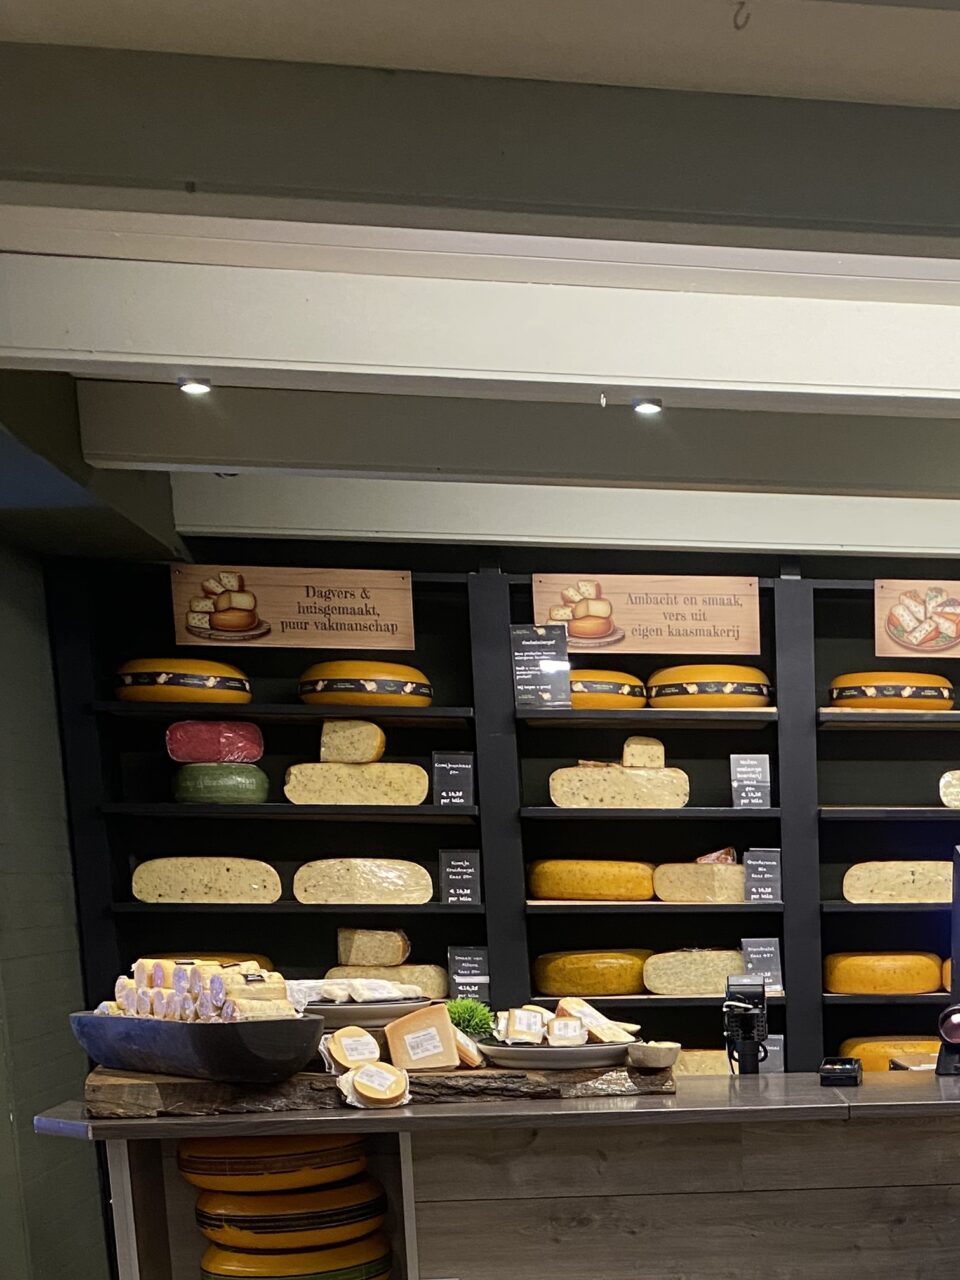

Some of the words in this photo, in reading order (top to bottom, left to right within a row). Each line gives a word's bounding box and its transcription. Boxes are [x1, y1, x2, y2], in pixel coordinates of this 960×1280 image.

[304, 585, 357, 601] Dagvers
[360, 587, 371, 600] &
[625, 592, 679, 607] Ambacht
[682, 595, 698, 607] en
[701, 593, 743, 608] smaak,
[297, 602, 381, 618] huisgemaakt,
[662, 611, 688, 622] vers
[690, 609, 708, 622] uit
[280, 620, 310, 633] puur
[313, 619, 399, 636] vakmanschap
[631, 626, 664, 641] eigen
[666, 624, 741, 641] kaasmakerij
